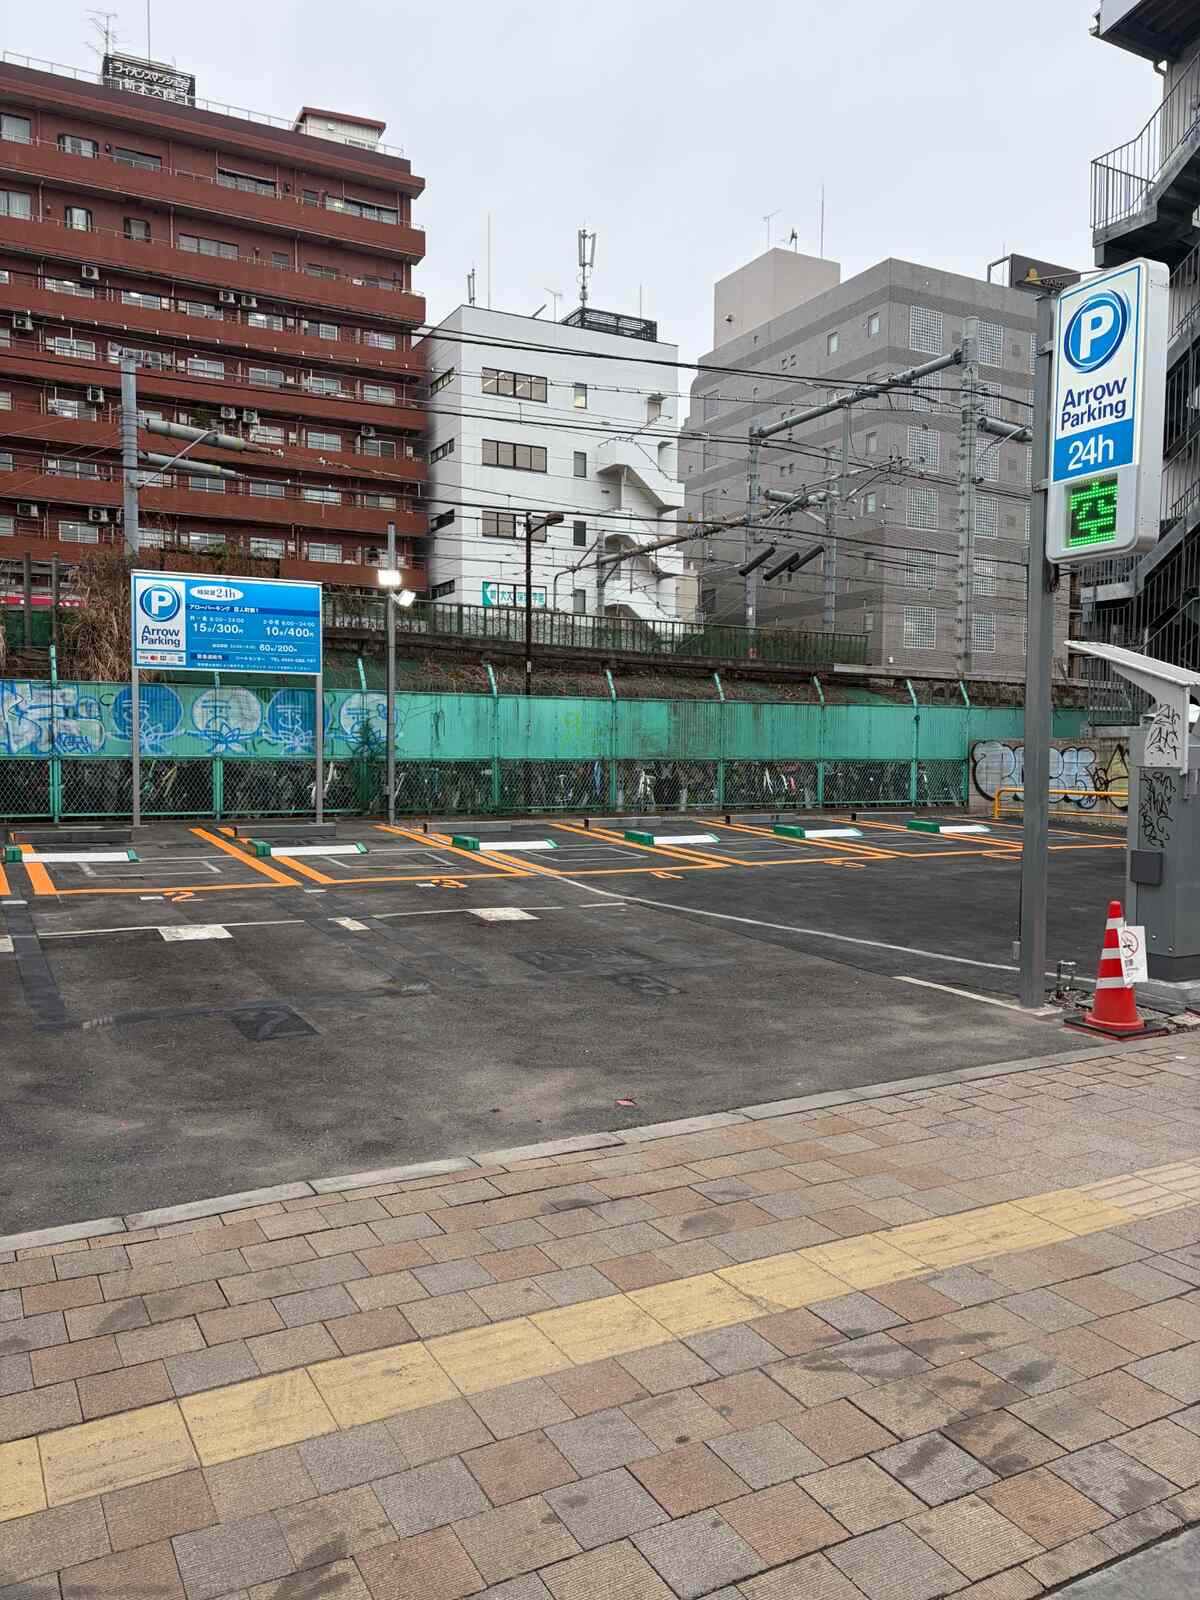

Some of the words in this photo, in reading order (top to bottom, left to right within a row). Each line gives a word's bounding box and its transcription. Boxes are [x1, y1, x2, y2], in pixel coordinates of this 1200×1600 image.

[1079, 304, 1115, 361] P
[1062, 377, 1128, 411] Arrow
[1060, 396, 1127, 432] Parking
[1067, 434, 1115, 472] 24h
[1069, 481, 1118, 547] 空
[151, 590, 173, 615] P
[141, 635, 181, 648] Parking
[142, 625, 180, 637] Arrow
